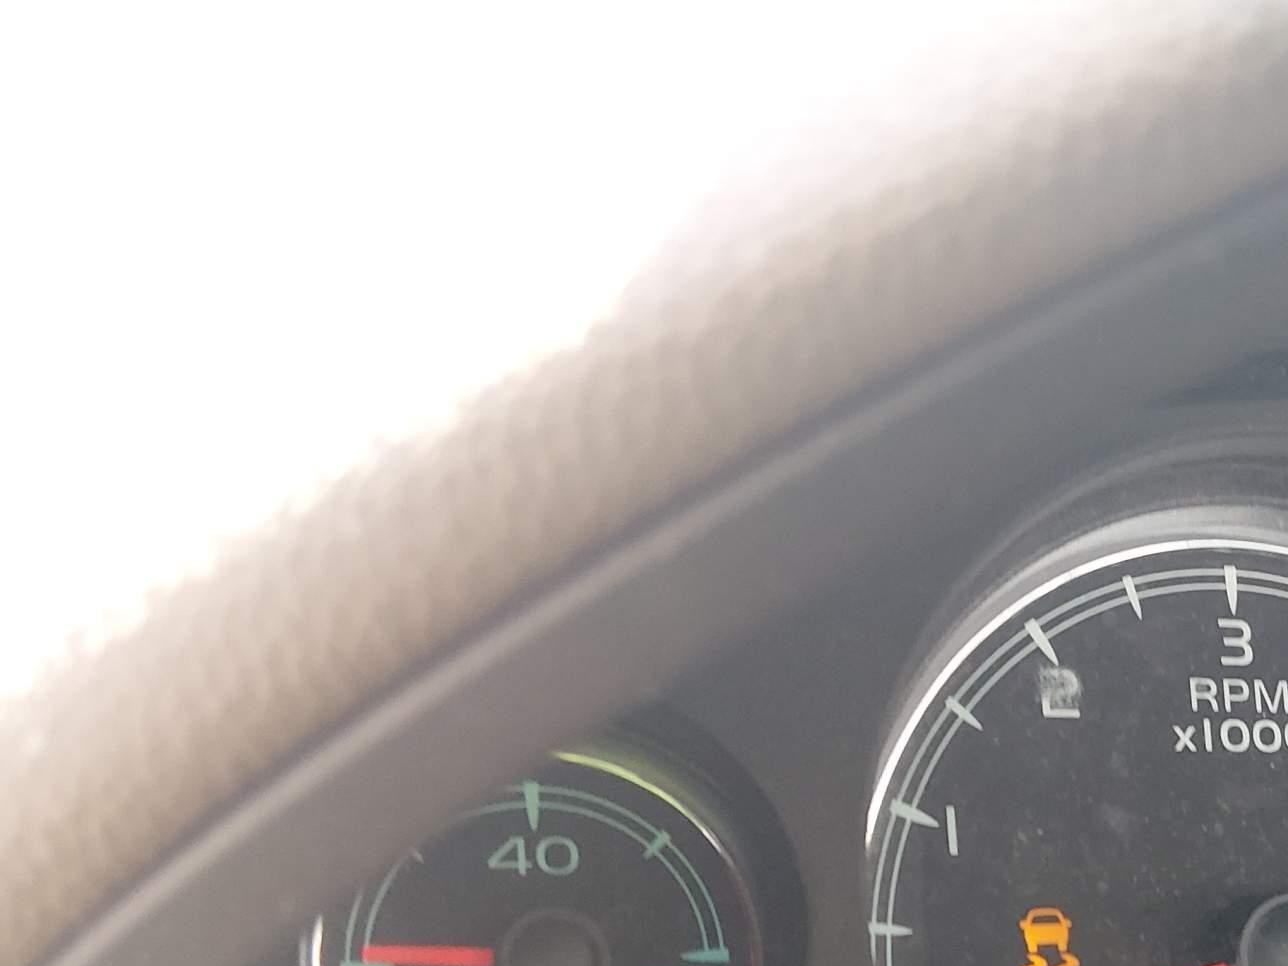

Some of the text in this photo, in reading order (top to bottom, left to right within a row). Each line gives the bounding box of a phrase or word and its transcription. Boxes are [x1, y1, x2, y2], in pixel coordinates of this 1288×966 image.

[1217, 617, 1255, 667] 3
[1040, 668, 1081, 718] 2
[946, 804, 960, 857] 1
[486, 835, 580, 877] 40
